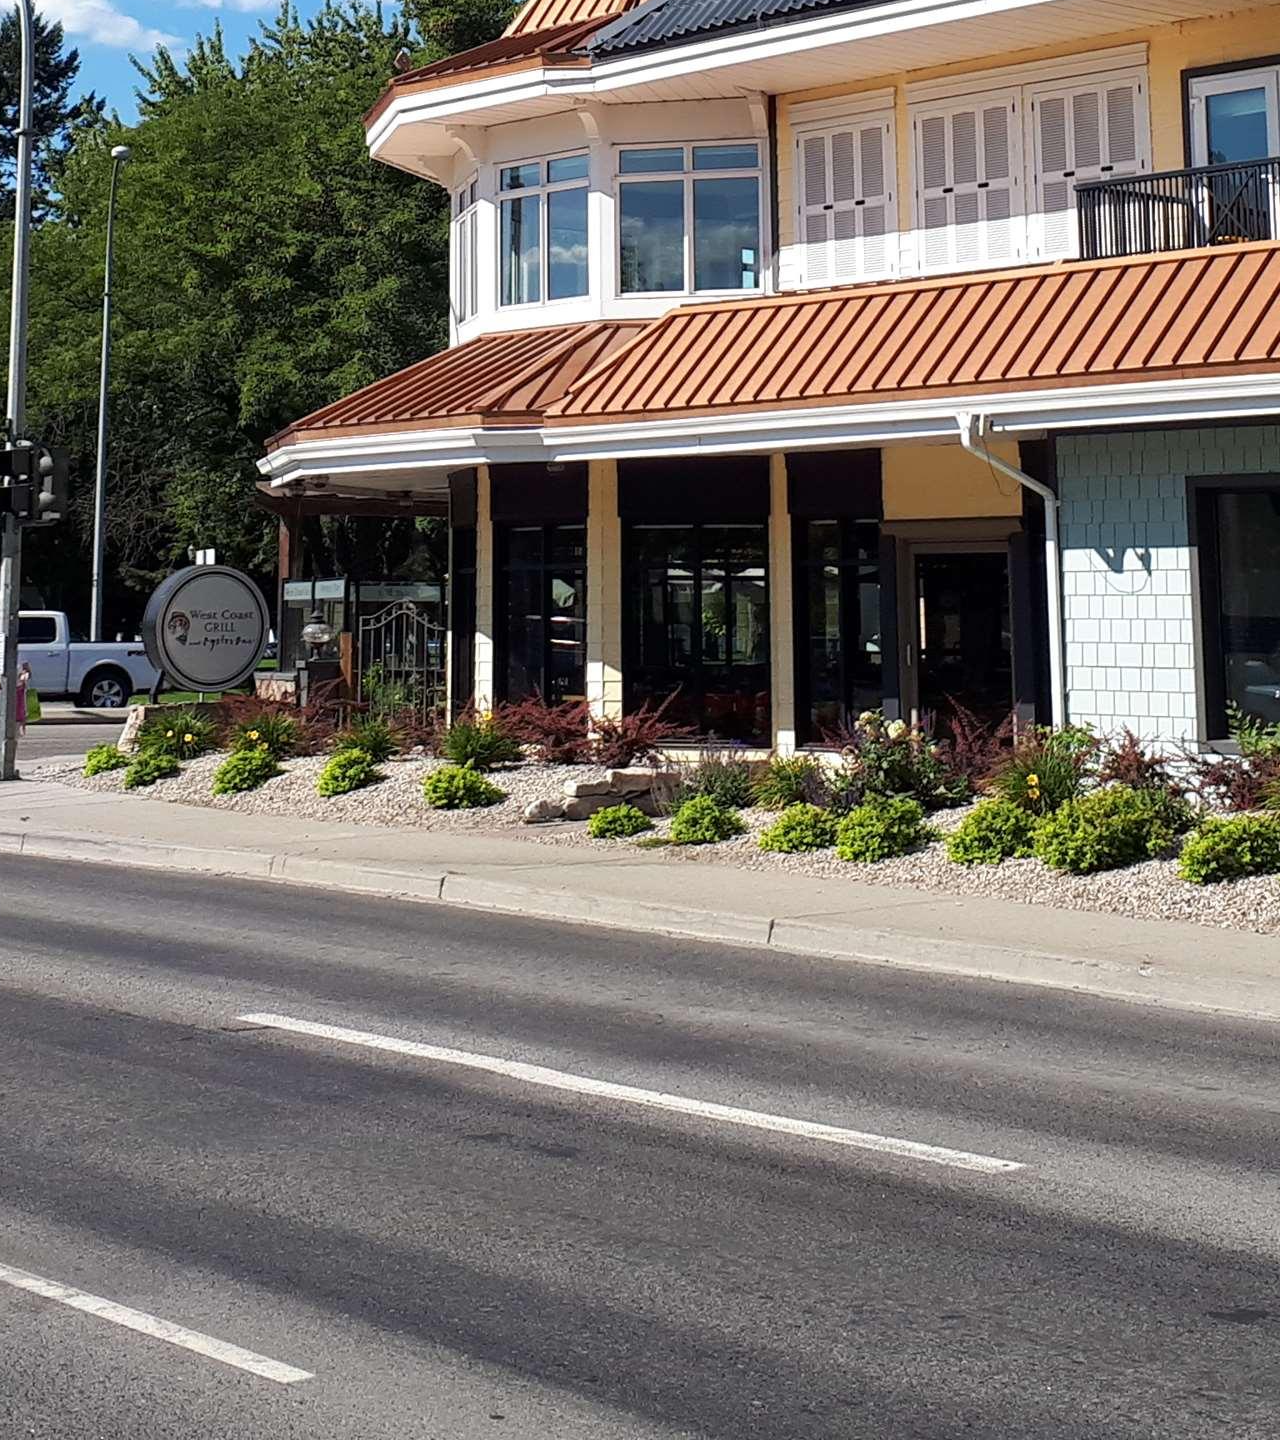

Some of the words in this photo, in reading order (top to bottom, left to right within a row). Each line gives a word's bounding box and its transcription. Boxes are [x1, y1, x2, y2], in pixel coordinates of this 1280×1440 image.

[190, 609, 218, 620] West
[221, 609, 255, 620] Coast
[204, 622, 236, 632] GRILL
